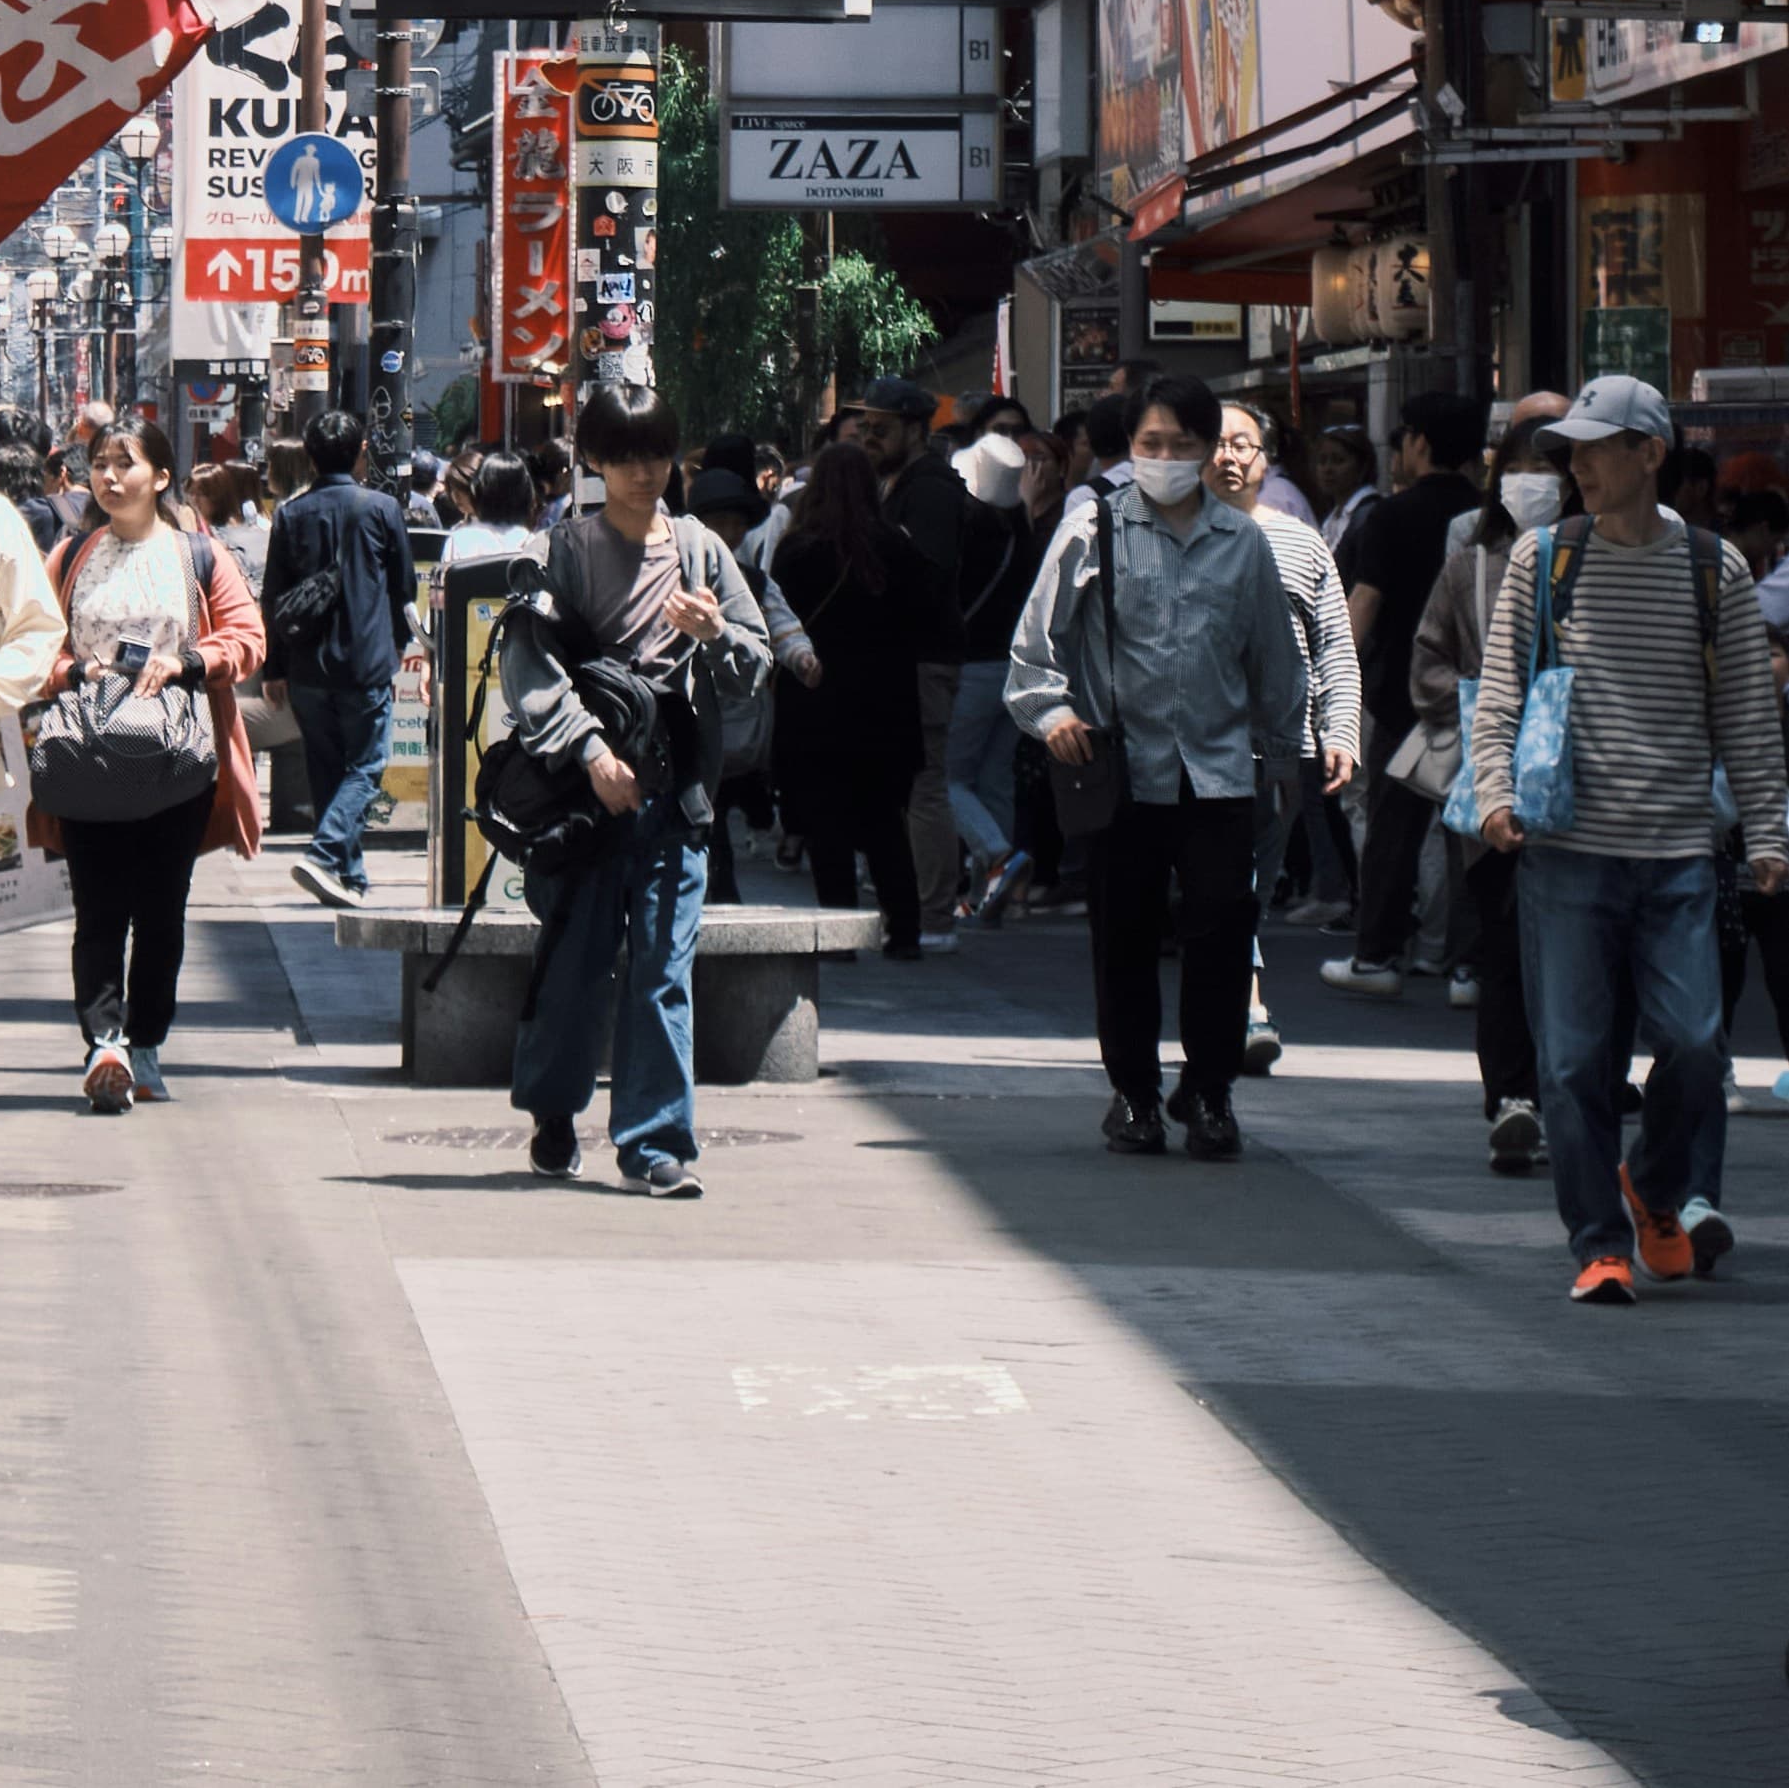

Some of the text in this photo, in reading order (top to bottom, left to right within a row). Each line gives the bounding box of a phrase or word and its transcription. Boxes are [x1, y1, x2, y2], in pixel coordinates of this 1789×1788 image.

[968, 40, 991, 62] B1
[738, 117, 771, 130] LIVE
[768, 138, 921, 181] ZAZA
[968, 146, 991, 168] B1
[804, 186, 885, 199] DOTONBORI
